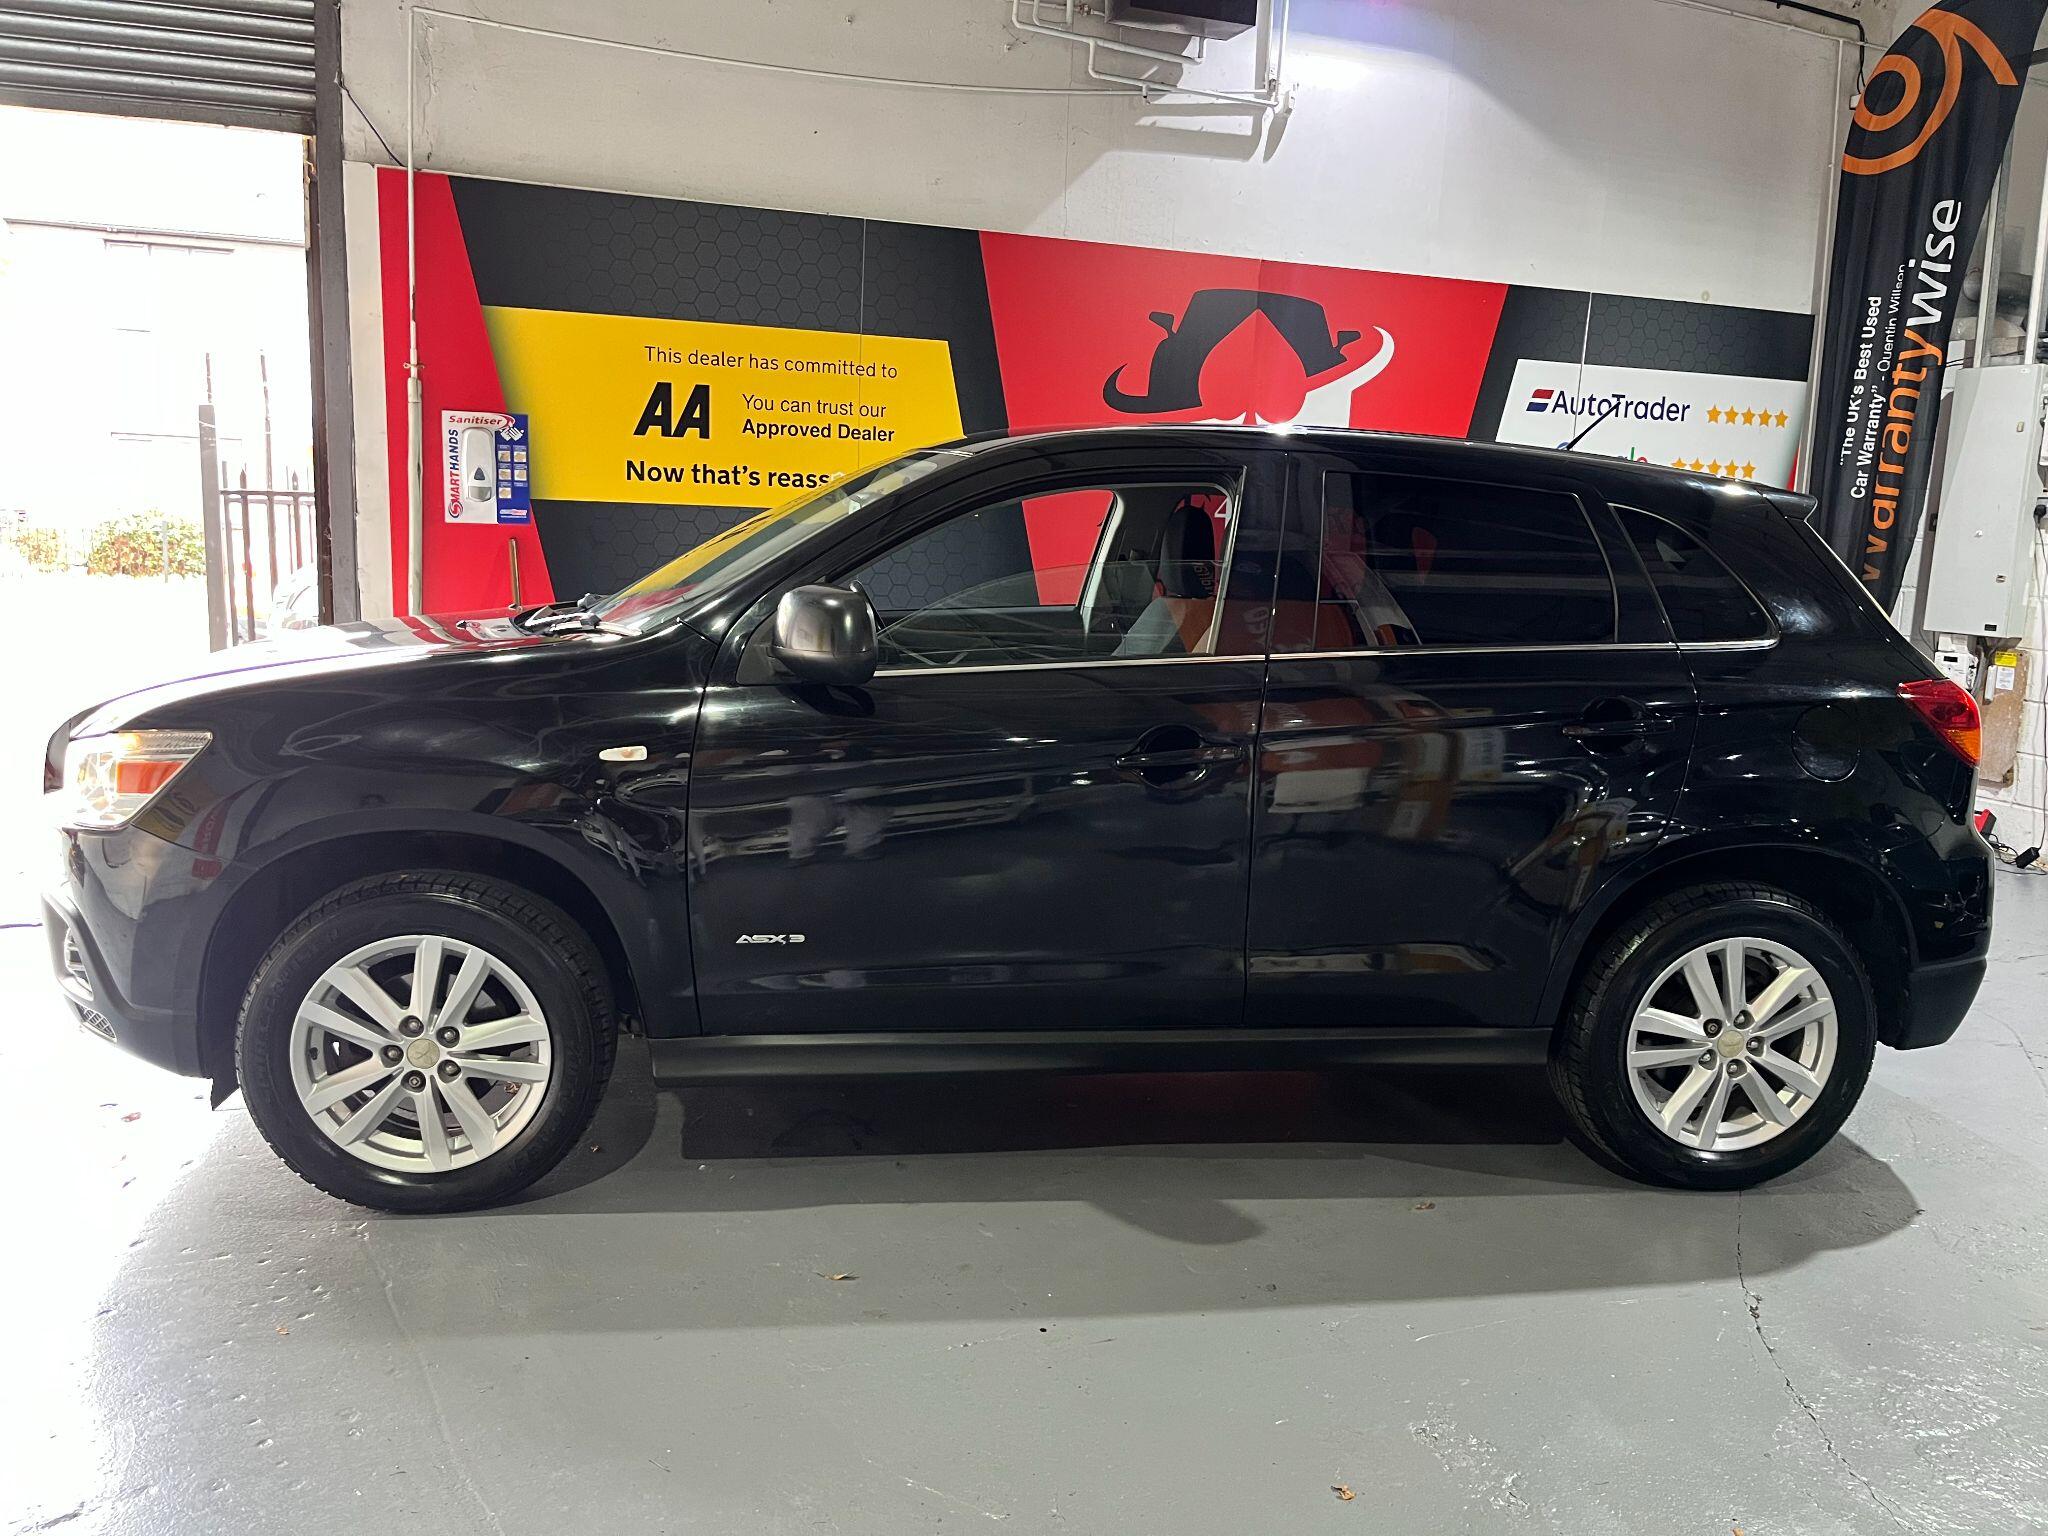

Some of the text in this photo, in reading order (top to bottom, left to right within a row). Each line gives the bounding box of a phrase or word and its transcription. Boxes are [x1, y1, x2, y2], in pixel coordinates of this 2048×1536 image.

[1861, 295, 1882, 340] Used
[644, 345, 898, 379] This dealer has committed to
[1854, 342, 1873, 381] Best
[1850, 469, 1869, 499] Car
[1877, 317, 1897, 373] Quentin
[1888, 263, 1906, 318] Willson
[448, 415, 503, 426] Sanitiser
[633, 381, 711, 440] AA
[742, 393, 887, 418] You can trust our
[1551, 389, 1692, 423] AutoTrader
[742, 418, 895, 442] Approved Dealer
[448, 428, 463, 518] SMARTHANDS
[626, 459, 685, 483] Now
[690, 463, 761, 486] that’s
[735, 934, 787, 944] ASX
